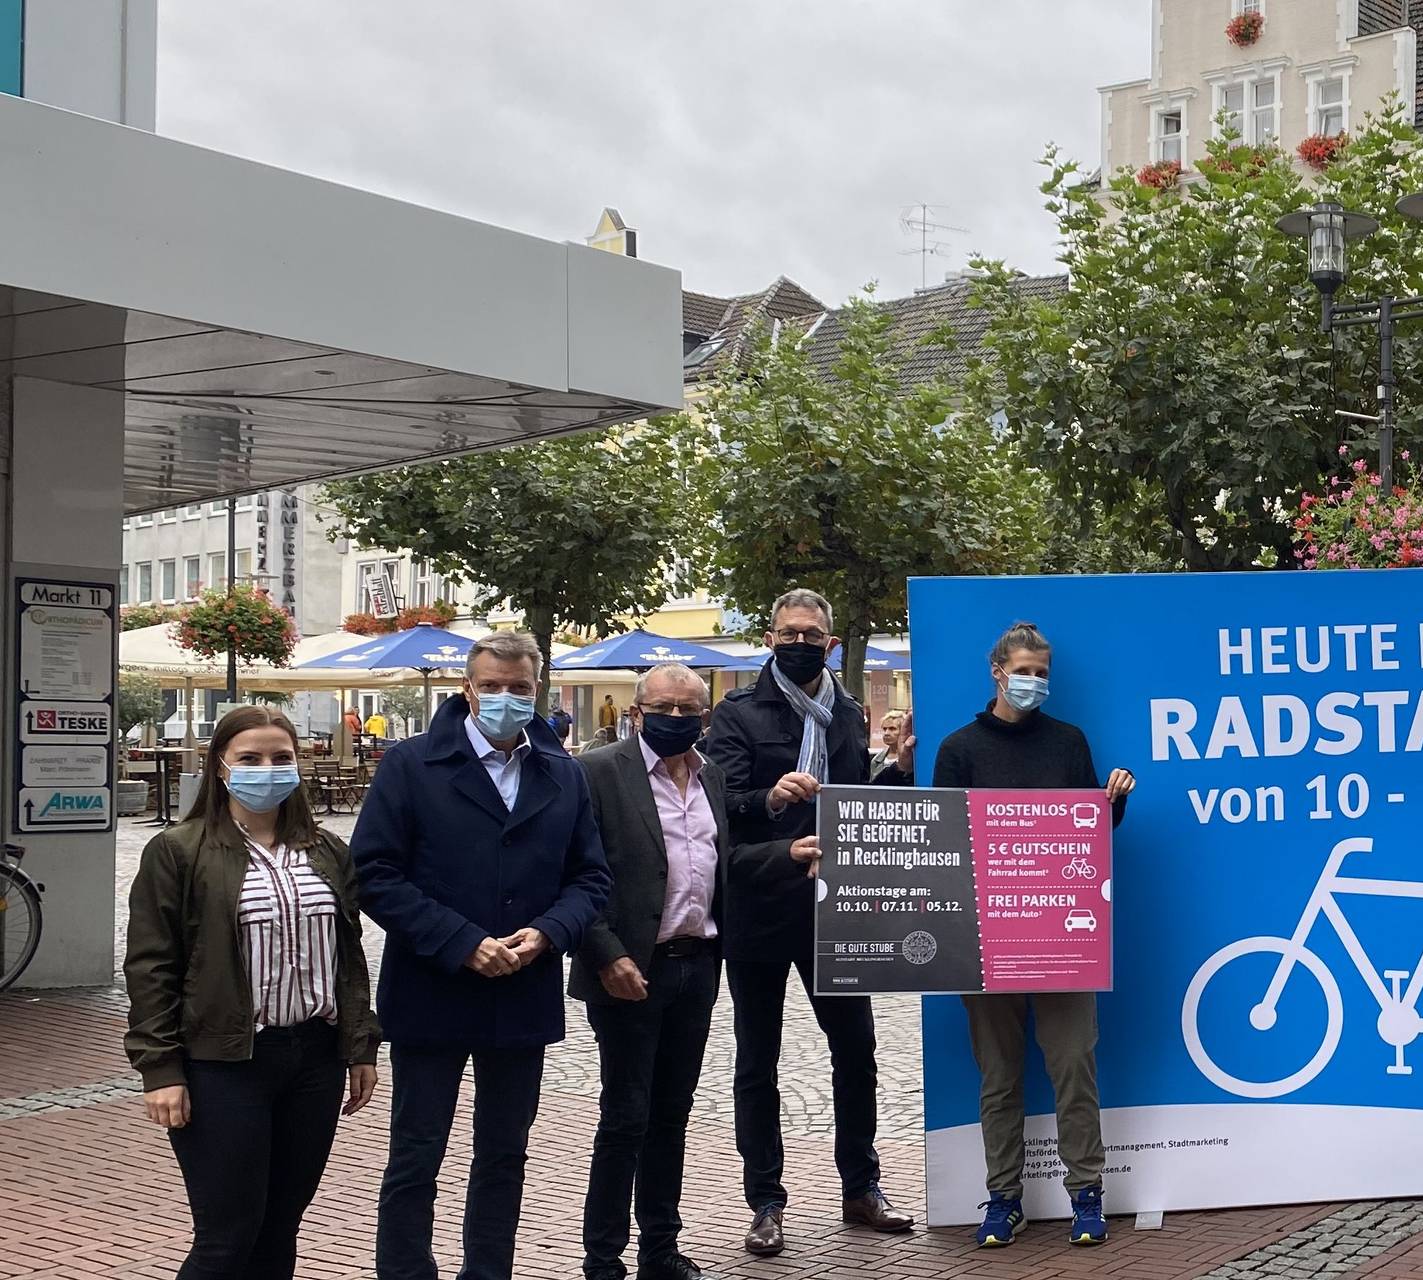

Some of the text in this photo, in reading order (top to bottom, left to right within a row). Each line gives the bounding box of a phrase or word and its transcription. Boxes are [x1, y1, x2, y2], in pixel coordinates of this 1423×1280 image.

[32, 586, 101, 605] Markt 11
[1218, 623, 1398, 676] HEUTE
[58, 717, 107, 729] TESKE
[40, 792, 103, 817] ARWA
[1187, 783, 1284, 825] von
[1305, 772, 1371, 820] 10
[838, 799, 940, 821] WIR HABEN FÜR
[986, 803, 1067, 816] KOSTENLOS
[986, 819, 999, 827] mit
[1000, 819, 1017, 827] dem
[837, 821, 931, 846] SIE GEÖFFNET,
[988, 842, 1091, 855] 5 € GUTSCHEIN
[837, 847, 960, 870] in Recklinghausen
[1004, 858, 1017, 866] mit
[1018, 858, 1035, 866] dem
[988, 868, 1017, 876] Fahrrad
[836, 885, 931, 898] Aktionstage am:
[836, 901, 962, 912] 10.10. 07.11. 05.12.
[988, 894, 1076, 907] FREI PARKEN
[834, 943, 895, 953] DIE GUTE STUBE
[1024, 1137, 1058, 1147] cklingha
[1102, 1136, 1229, 1152] ortmanagement, Stadtmarketing
[1026, 1148, 1057, 1157] ftsförde
[1025, 1159, 1062, 1169] +49 2361
[1101, 1164, 1132, 1175] usen.de
